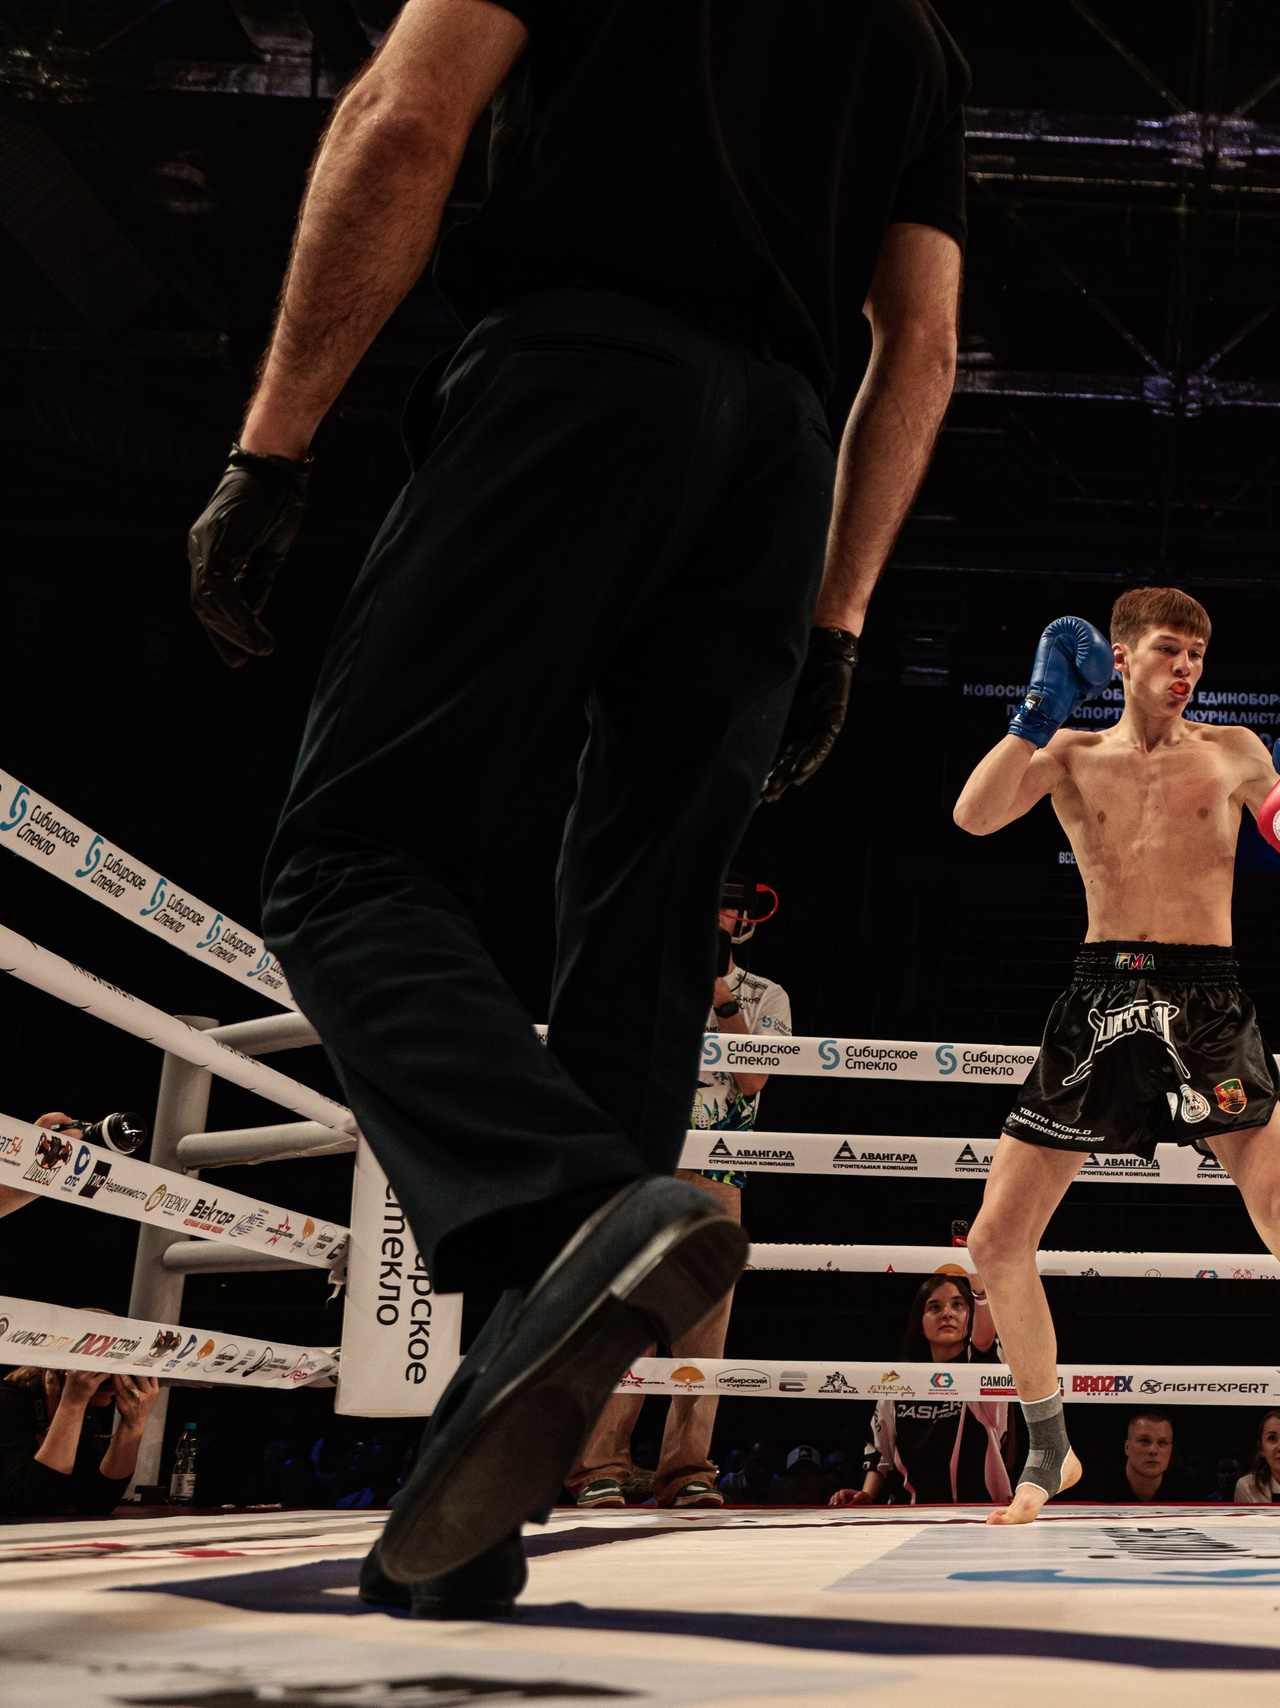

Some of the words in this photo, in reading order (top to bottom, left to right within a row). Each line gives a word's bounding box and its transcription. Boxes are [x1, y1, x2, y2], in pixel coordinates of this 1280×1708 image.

[1073, 706, 1123, 720] СПОРТ
[30, 805, 80, 848] Сибирское
[16, 823, 56, 856] Стекло
[102, 853, 147, 890] Сибирское
[90, 869, 125, 897] Стекло
[166, 894, 205, 927] Сибирское
[153, 909, 185, 933] Стекло
[221, 928, 257, 957] Сибирское
[208, 941, 237, 964] Стекло
[727, 1041, 800, 1055] Сибирское
[845, 1046, 918, 1060] Сибирское
[727, 1054, 780, 1066] Стекло
[845, 1058, 898, 1071] Стекло
[962, 1051, 1034, 1064] Сибирское
[962, 1063, 1014, 1076] Стекло
[1019, 1106, 1049, 1124] YOUTH
[1052, 1121, 1092, 1135] WORLD
[736, 1149, 795, 1160] АВАНГАРД
[860, 1152, 918, 1163] АВАНГАРД
[1104, 1158, 1160, 1169] АВАНГАРД
[64, 1175, 80, 1187] ОТС
[104, 1178, 148, 1201] Недвижимость
[112, 1337, 142, 1352] СТРОЙ
[719, 1376, 768, 1385] сибирский
[1072, 1375, 1134, 1392] BROZEX
[1163, 1382, 1269, 1394] FIGHTEXPERT
